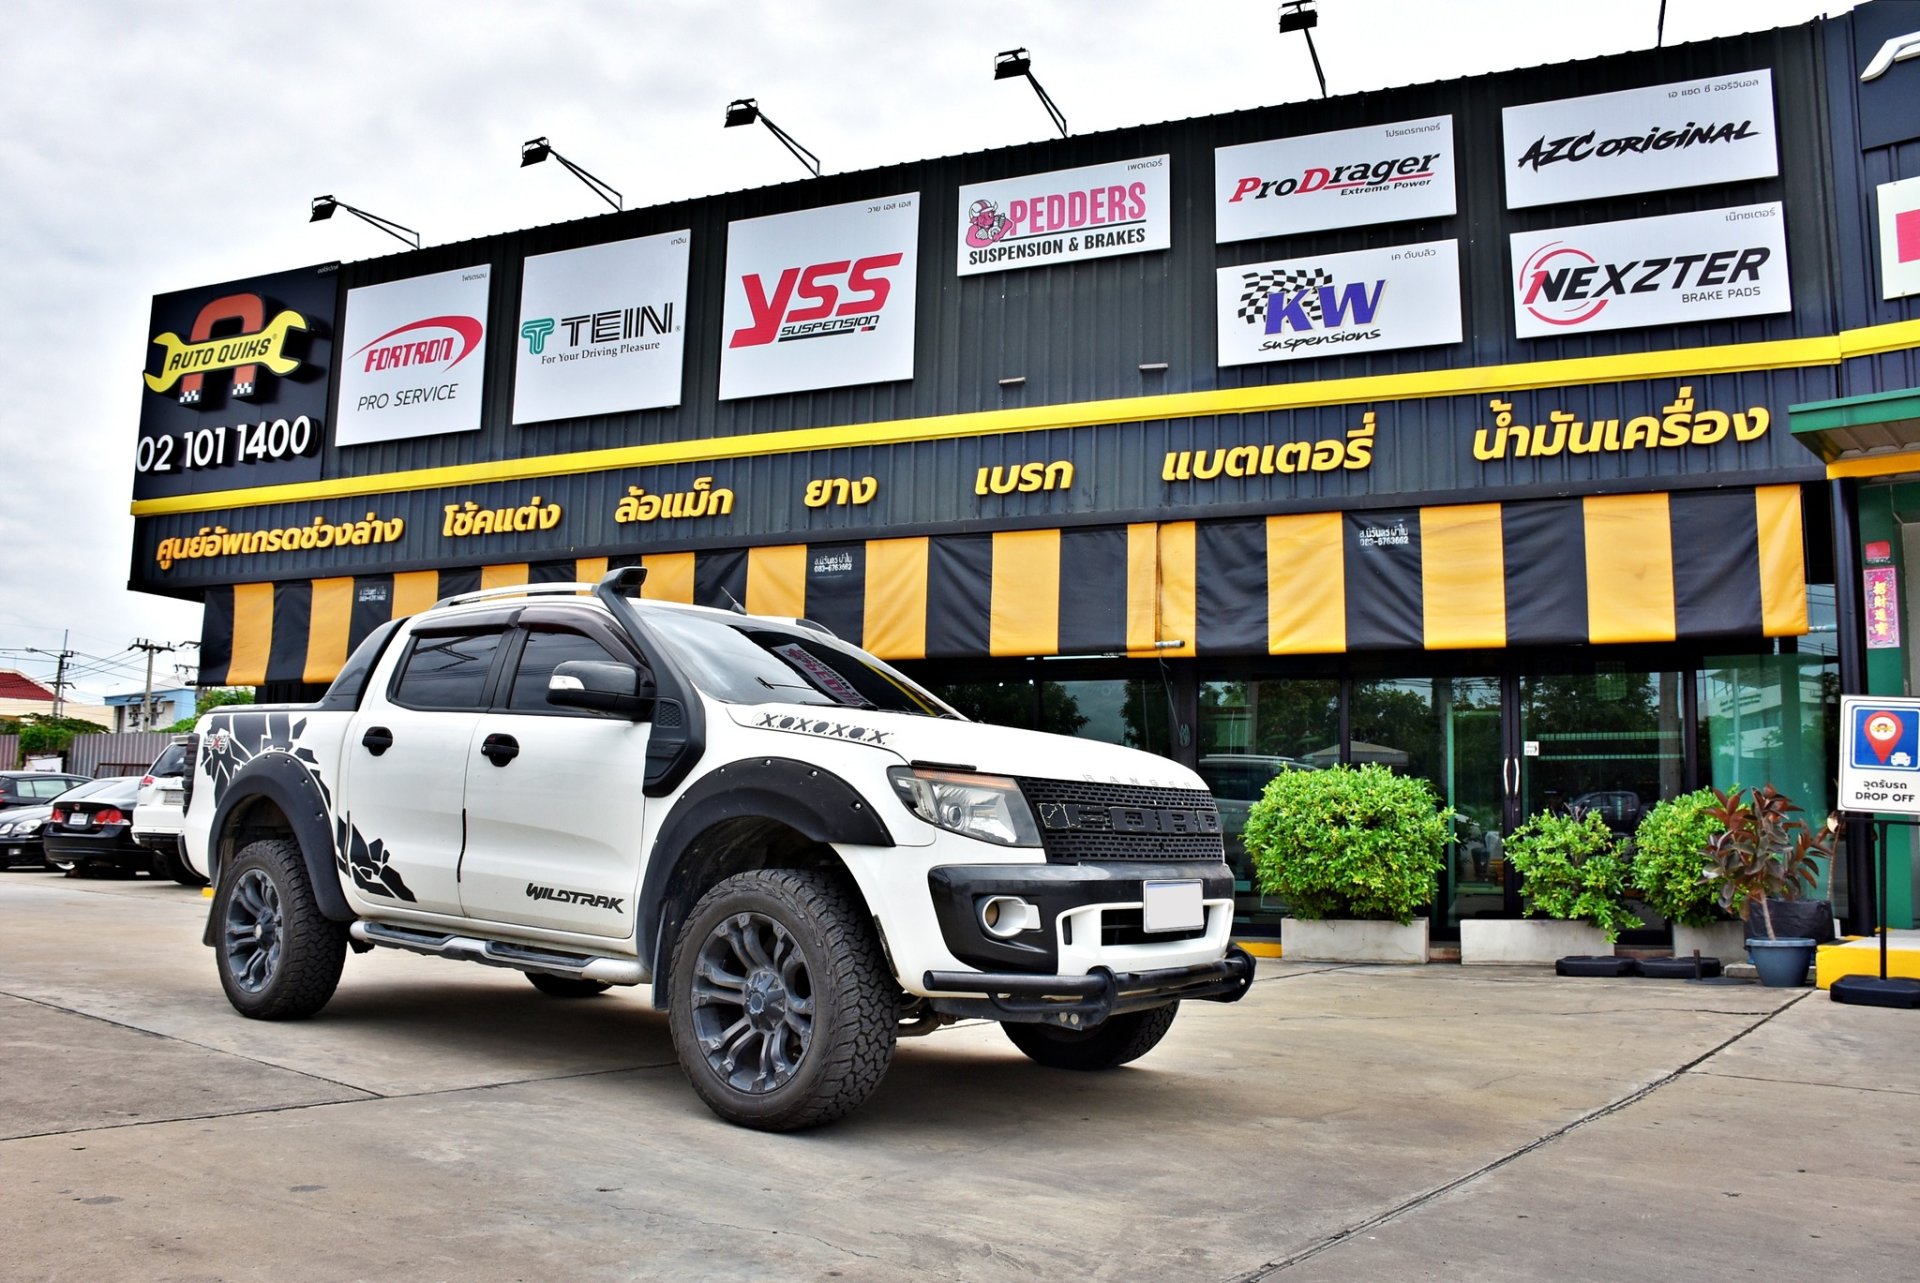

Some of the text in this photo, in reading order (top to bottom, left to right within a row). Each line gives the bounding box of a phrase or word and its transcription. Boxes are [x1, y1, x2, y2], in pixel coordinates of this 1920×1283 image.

[1518, 129, 1596, 173] AZC
[1229, 153, 1440, 203] ProDrager
[1341, 179, 1432, 196] Extreme Power
[1009, 181, 1146, 236] PEDDERS
[969, 227, 1146, 265] SUSPENSION & BRAKES
[1522, 247, 1771, 305] NEXZTER
[1682, 286, 1761, 303] BRAKE PADS
[729, 252, 903, 348] YSS
[1265, 279, 1386, 335] KW
[561, 302, 673, 347] TEIN
[780, 315, 880, 336] SUSPENSION
[1258, 329, 1382, 352] suspensions
[168, 347, 215, 371] AUTO
[364, 337, 455, 372] FORTRON
[541, 342, 660, 364] For Your Driving Pleasure
[358, 383, 459, 411] PRO SERVICE
[1473, 386, 1770, 460] น้ำมันเครื่อง
[136, 415, 311, 473] 02 101 1400
[1162, 411, 1375, 480] แบตเตอรี่
[805, 476, 878, 508] ยาง
[975, 460, 1074, 495] เบรก
[442, 496, 562, 537] โช้คแต่ง
[614, 477, 734, 523] ล้อแม็ก
[157, 512, 405, 569] ศูนย์อัพเกรดช่วงล่าง
[1855, 791, 1915, 803] DROP OFF
[1863, 779, 1907, 790] จุดรับรถ
[526, 883, 624, 914] WILDTRAK
